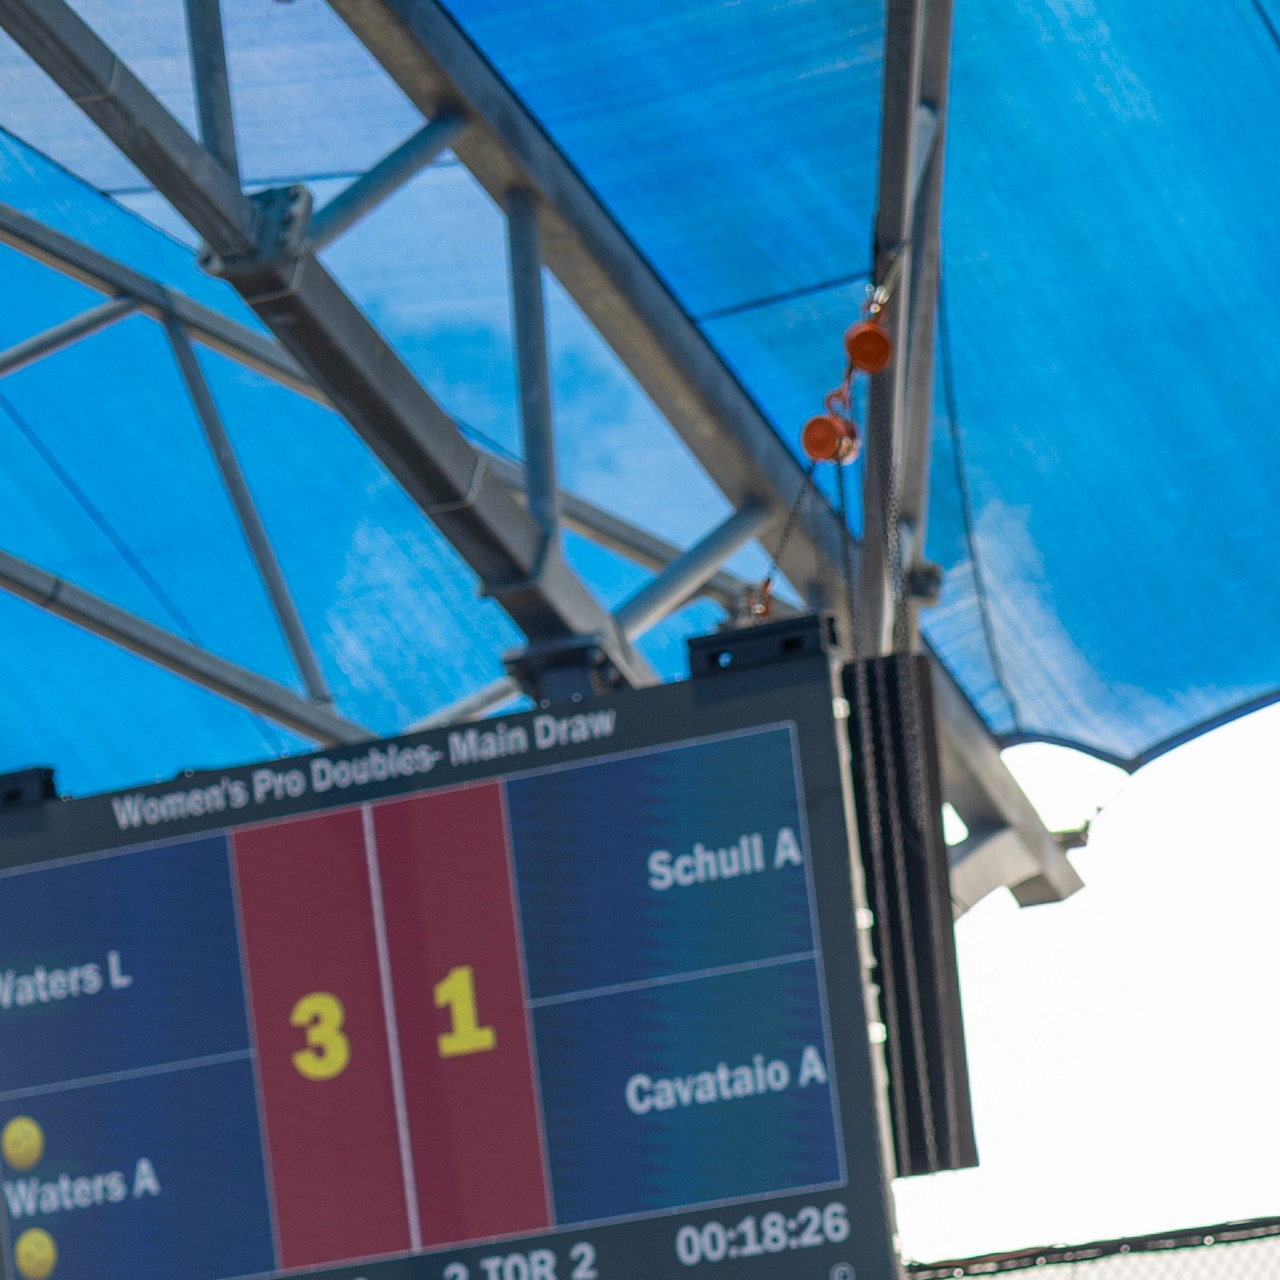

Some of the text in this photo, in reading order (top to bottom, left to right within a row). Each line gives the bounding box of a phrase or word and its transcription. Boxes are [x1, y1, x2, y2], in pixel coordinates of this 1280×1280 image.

[112, 777, 249, 830] Women's
[253, 768, 306, 802] Pro
[448, 722, 528, 767] Main
[533, 708, 617, 750] Draw
[647, 827, 804, 890] Schull A
[107, 949, 134, 990] L
[290, 991, 350, 1081] 3
[434, 964, 496, 1059] 1
[625, 1045, 827, 1115] Cavataio A
[3, 1157, 161, 1219] Waters A
[675, 1202, 851, 1266] 00:18:26
